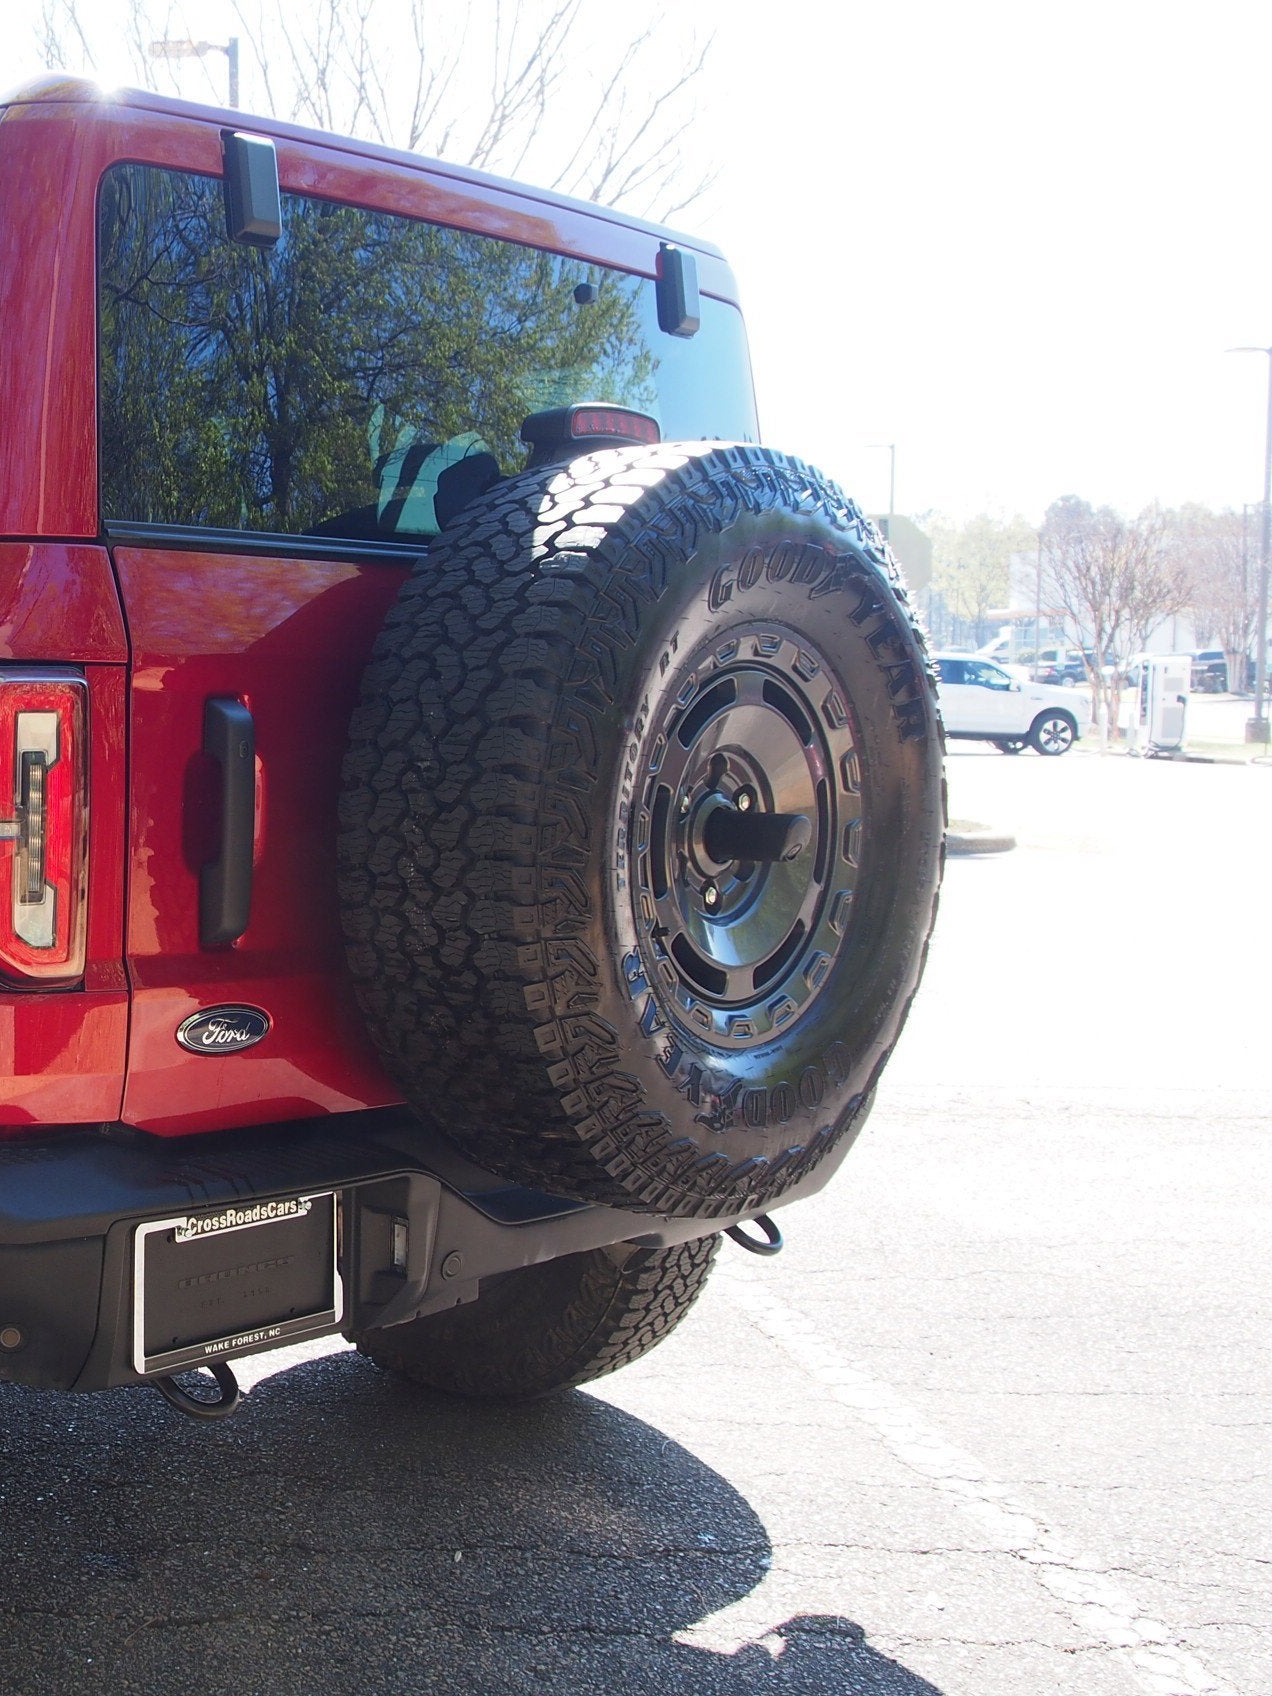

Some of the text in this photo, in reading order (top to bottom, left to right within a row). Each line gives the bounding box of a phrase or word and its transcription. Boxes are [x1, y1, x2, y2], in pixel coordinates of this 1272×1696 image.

[202, 1017, 252, 1045] Ford
[187, 1199, 298, 1235] CrossRoadsCars
[204, 1327, 282, 1354] WAKE FOREST, NC
